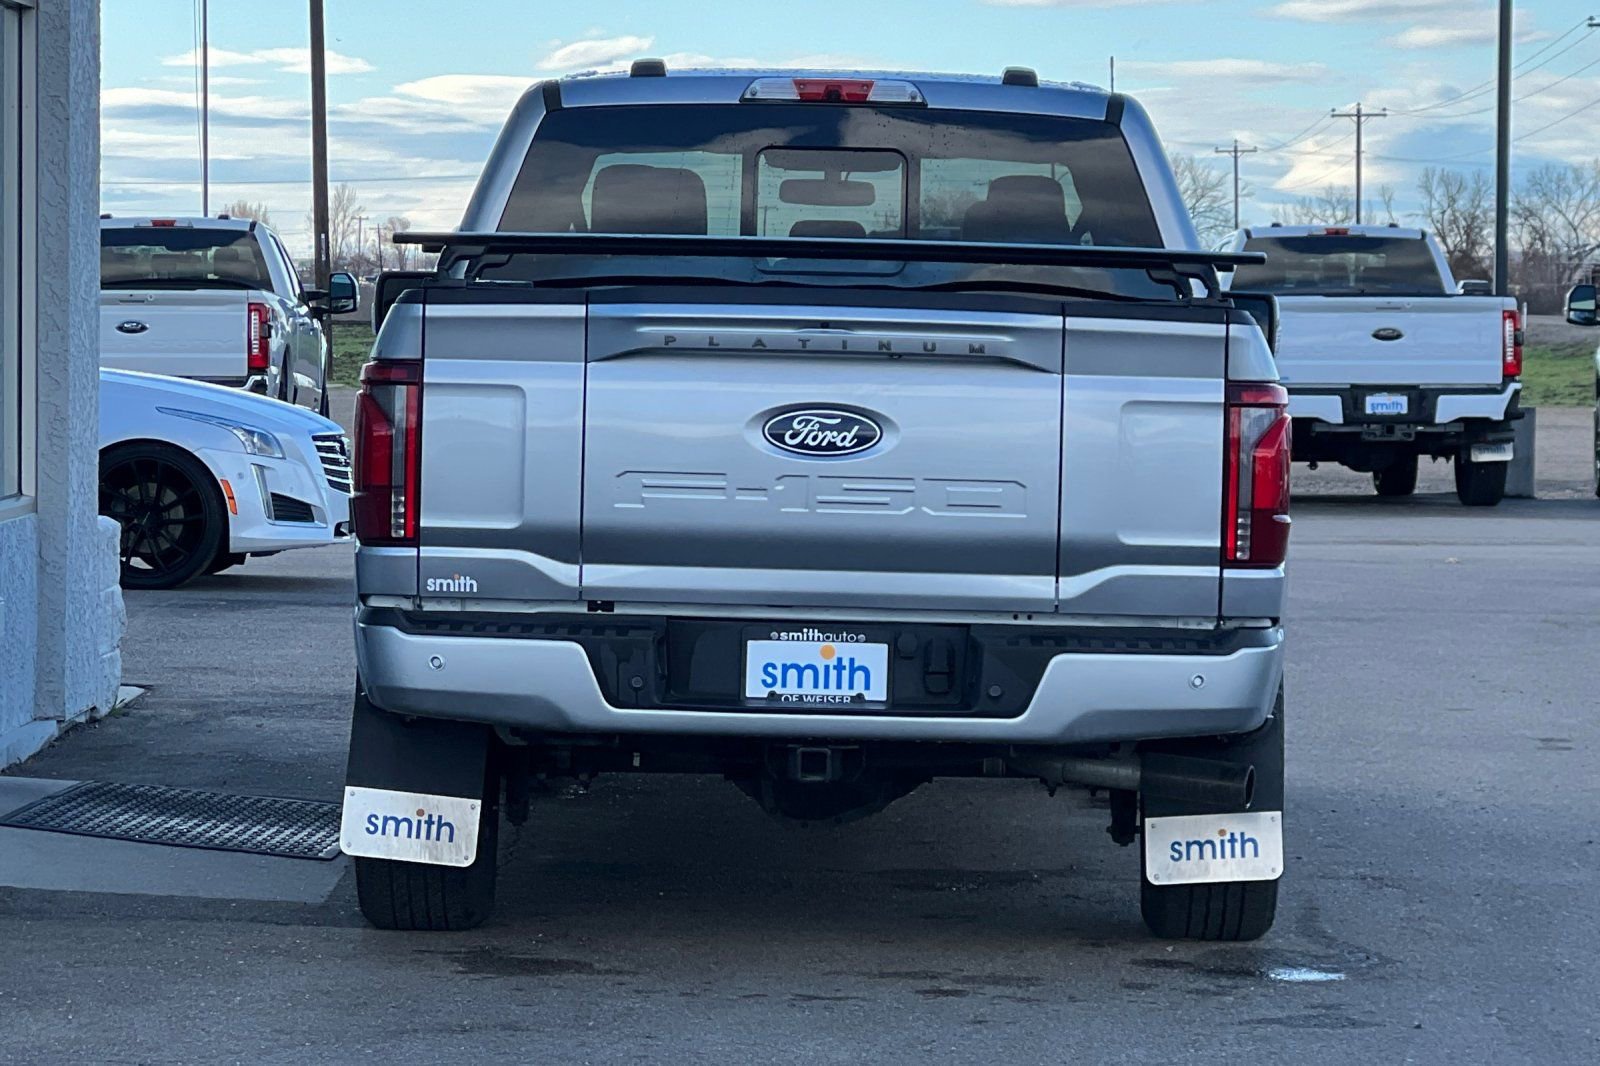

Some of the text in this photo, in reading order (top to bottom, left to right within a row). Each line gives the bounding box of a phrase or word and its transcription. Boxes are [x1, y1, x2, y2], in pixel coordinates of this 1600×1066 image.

[664, 334, 986, 354] PLATINUM
[784, 415, 861, 448] Ford
[613, 471, 1027, 519] F-150
[427, 574, 478, 593] smith
[761, 645, 871, 691] smith
[365, 808, 455, 843] smith
[1170, 828, 1260, 862] smith
